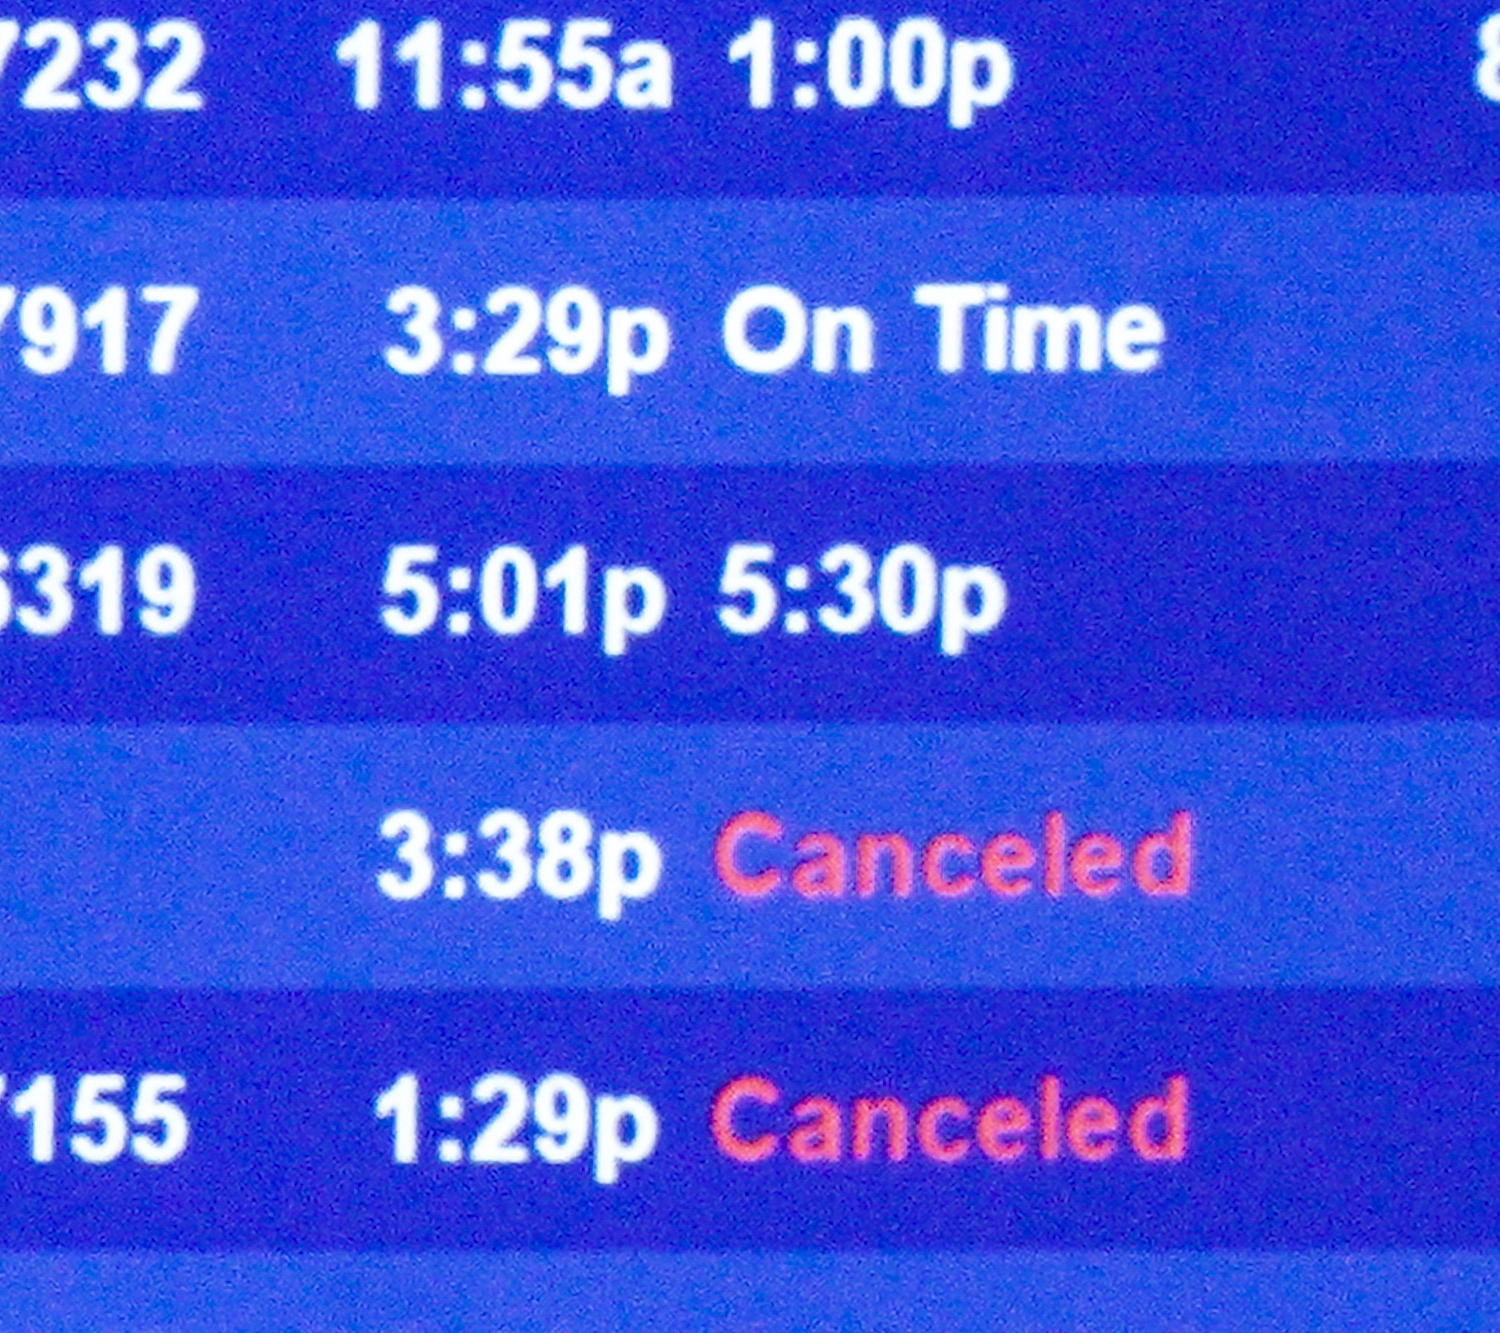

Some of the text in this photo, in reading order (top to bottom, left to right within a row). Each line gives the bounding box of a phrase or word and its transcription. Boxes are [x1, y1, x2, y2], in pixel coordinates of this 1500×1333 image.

[336, 16, 674, 112] 11:55a
[727, 15, 1015, 130] 1:00p
[383, 283, 675, 399] 3:29p
[721, 281, 1167, 376] On Time
[381, 543, 669, 657] 5:01p
[718, 542, 1009, 657] 5:30p
[376, 807, 666, 923] 3:38p
[712, 809, 1197, 903] Canceled
[375, 1071, 661, 1186] 1:29p
[710, 1073, 1190, 1165] Canceled
